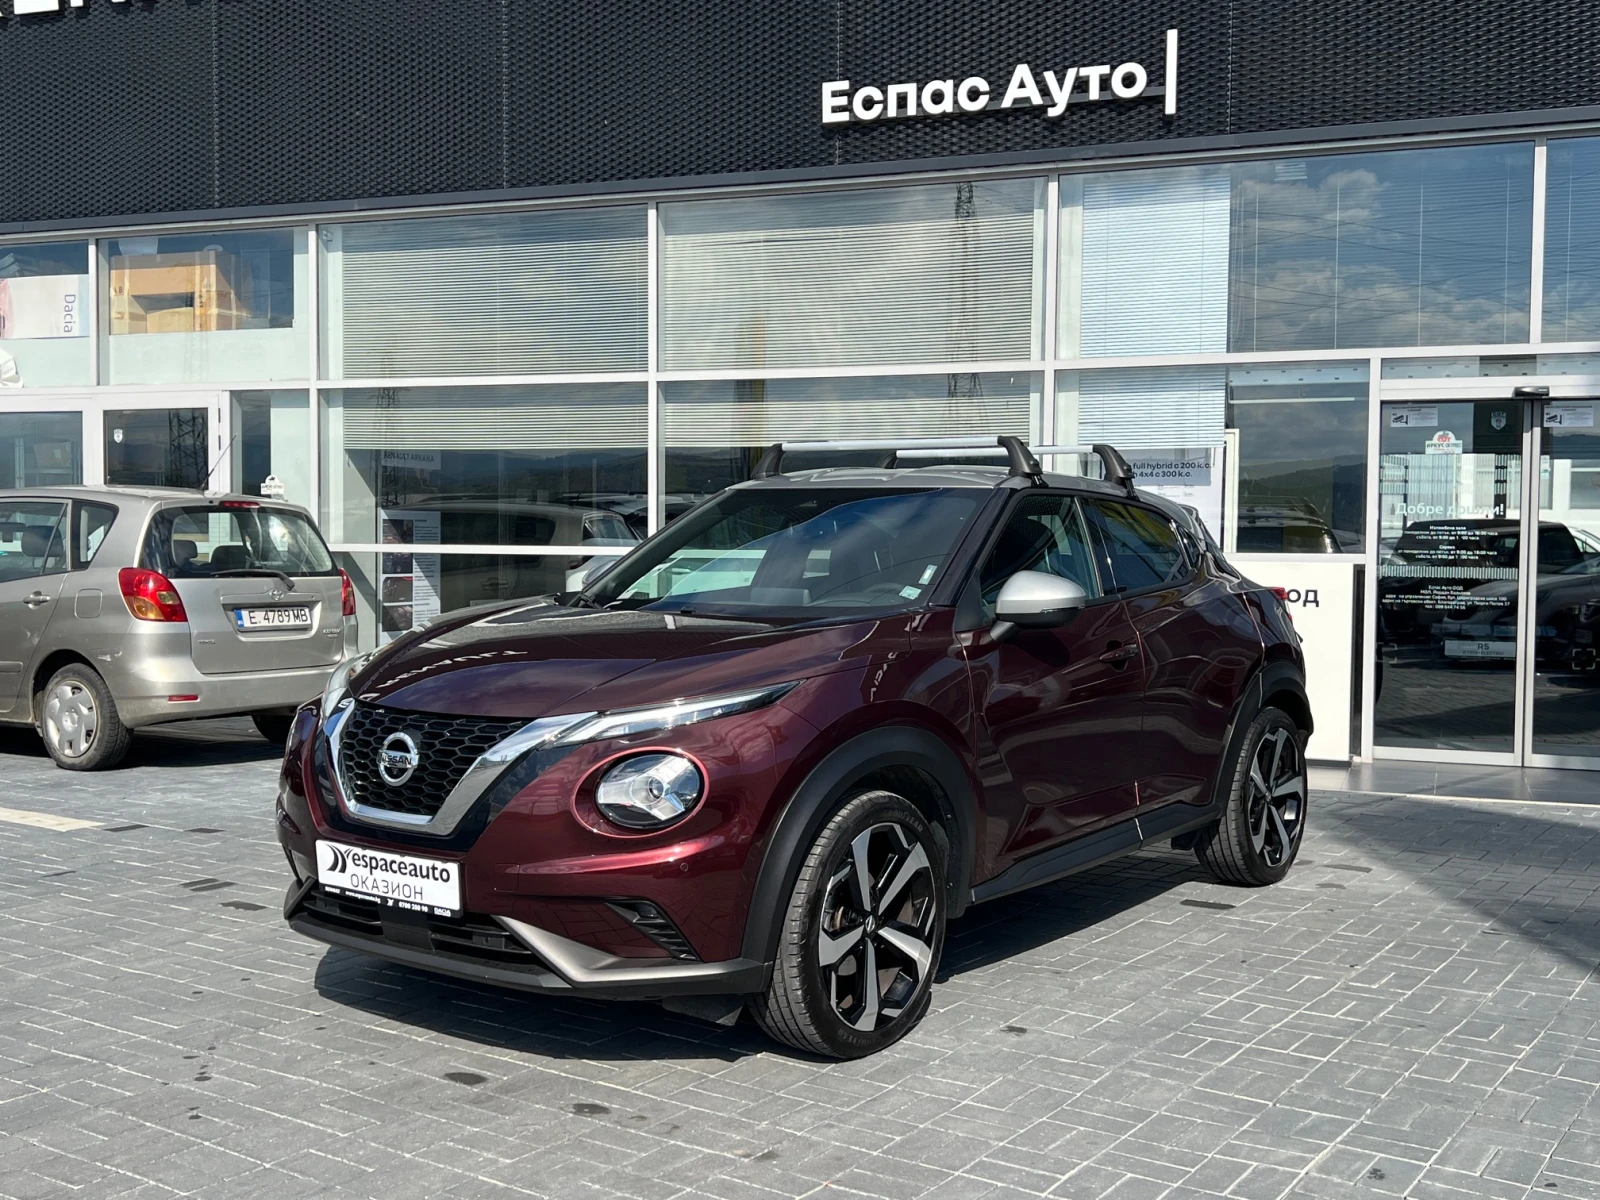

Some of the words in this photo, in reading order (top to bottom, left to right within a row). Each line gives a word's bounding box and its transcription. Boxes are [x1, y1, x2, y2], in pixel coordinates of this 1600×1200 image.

[822, 78, 990, 123] Еспас
[1001, 61, 1147, 117] Ауто
[64, 294, 76, 332] Dacia
[1147, 462, 1173, 471] hybrid
[1395, 502, 1444, 516] Добре
[1285, 589, 1319, 607] ОД
[381, 751, 413, 765] NISSAN
[351, 852, 451, 883] espaceauto
[350, 873, 424, 901] ОКАЗИОН
